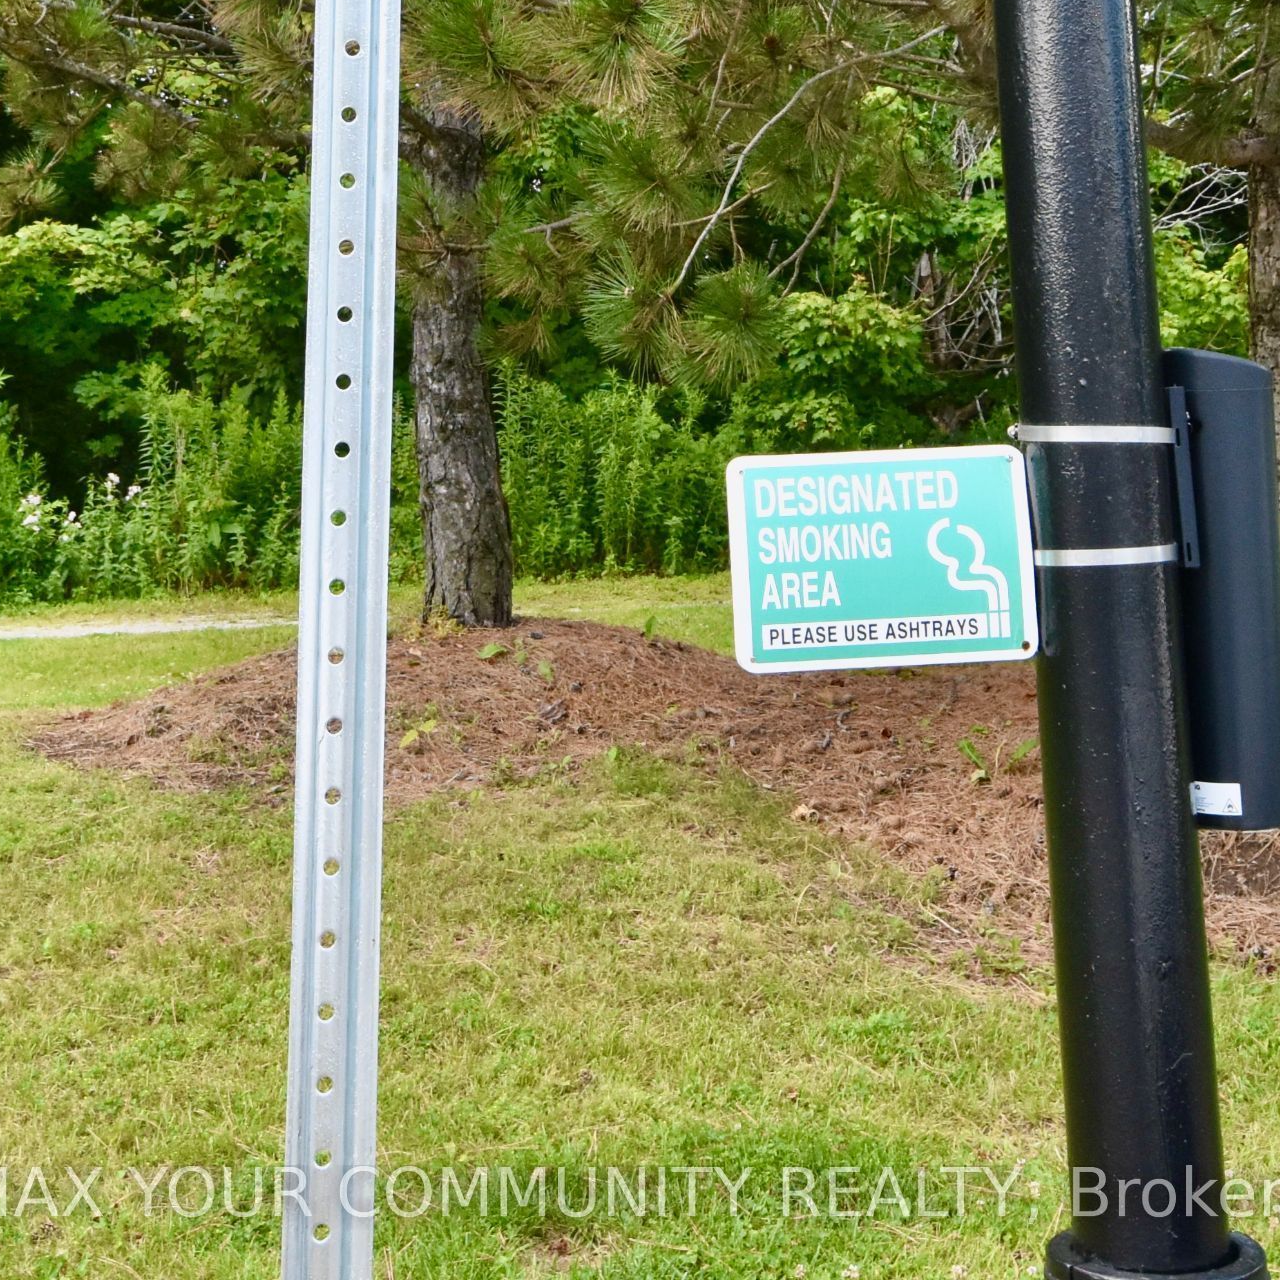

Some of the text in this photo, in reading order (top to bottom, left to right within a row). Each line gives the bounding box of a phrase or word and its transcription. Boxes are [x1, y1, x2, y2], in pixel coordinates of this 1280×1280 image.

[753, 470, 959, 518] DESIGNATED
[758, 522, 893, 565] SMOKING
[761, 570, 842, 611] AREA
[769, 617, 980, 646] PLEASE USE ASHTRAYS
